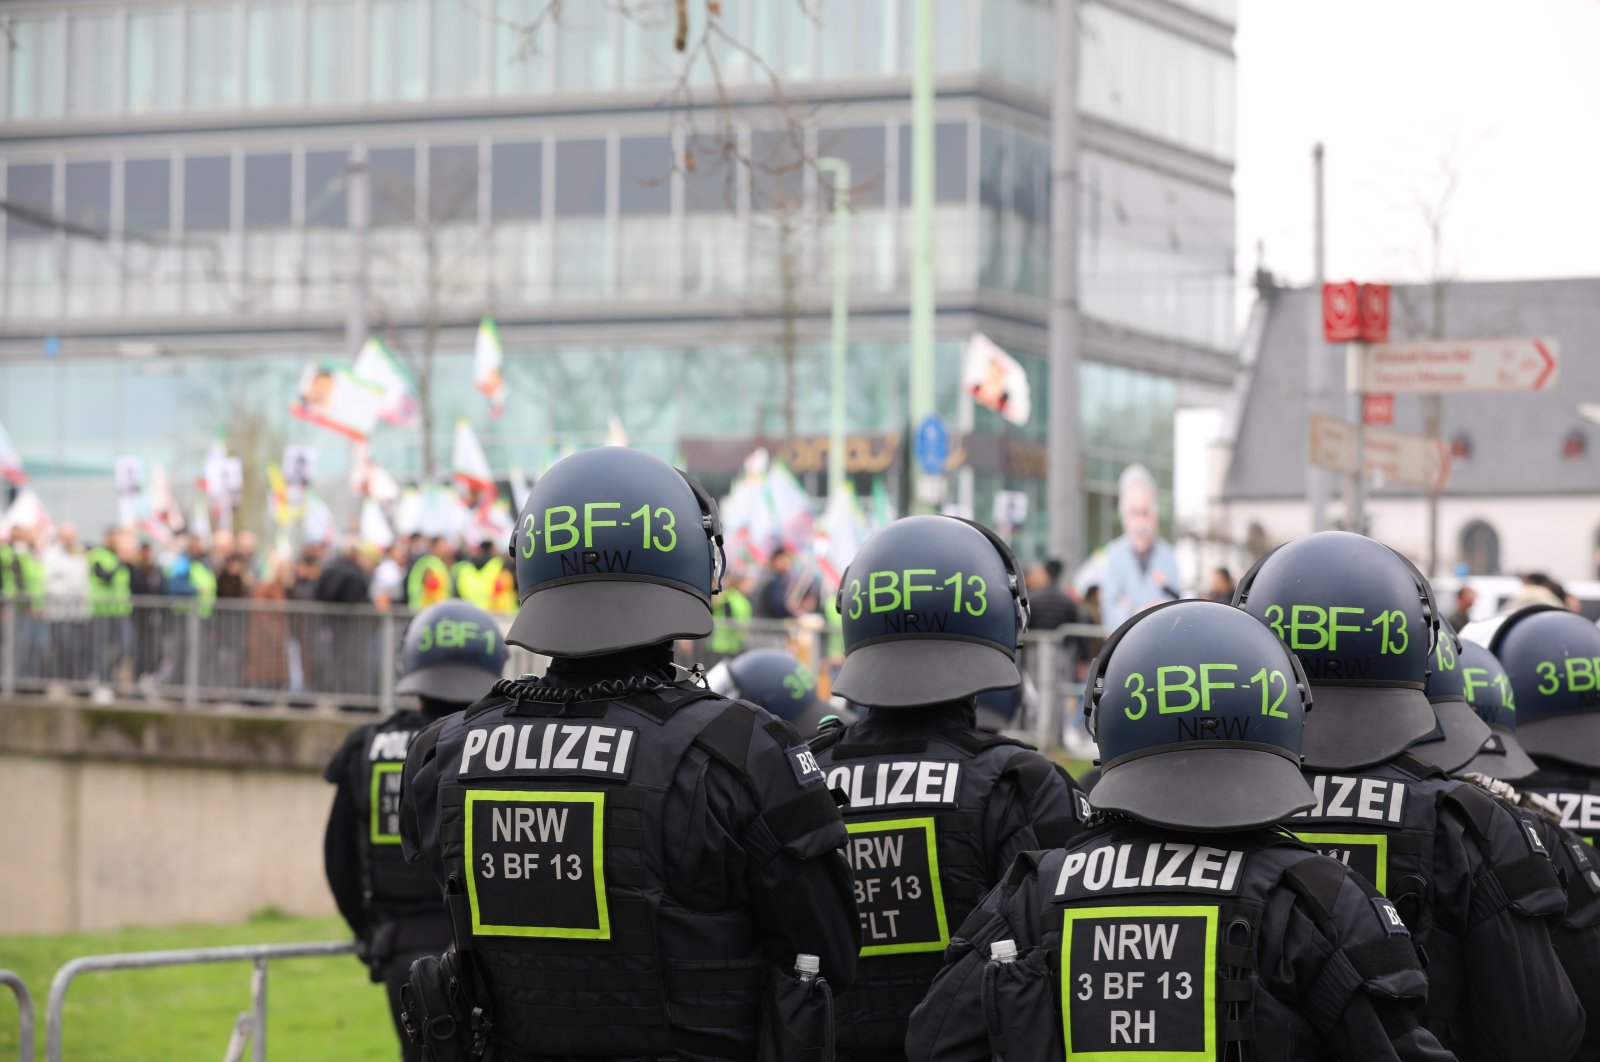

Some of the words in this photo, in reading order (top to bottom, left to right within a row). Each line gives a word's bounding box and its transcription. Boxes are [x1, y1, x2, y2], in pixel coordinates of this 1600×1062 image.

[522, 503, 677, 559] 3-BF-13
[560, 550, 632, 577] NRW
[849, 569, 988, 620] 3-BF-13
[884, 612, 948, 634] NRW
[1124, 663, 1289, 721] 3-BF-12
[1177, 716, 1250, 741] NRW
[459, 723, 634, 775] POLIZEI
[820, 760, 963, 809] OLIZEI
[492, 807, 569, 843] NRW
[481, 852, 495, 879] 3
[503, 853, 540, 879] BF
[550, 853, 583, 881] 13
[1054, 842, 1244, 896] POLIZEI
[890, 875, 922, 900] 13
[1093, 923, 1180, 961] NRW
[1077, 973, 1093, 1001] 3
[1103, 971, 1146, 1001] BF
[1156, 971, 1193, 1000] 13
[1110, 1009, 1156, 1044] RH
